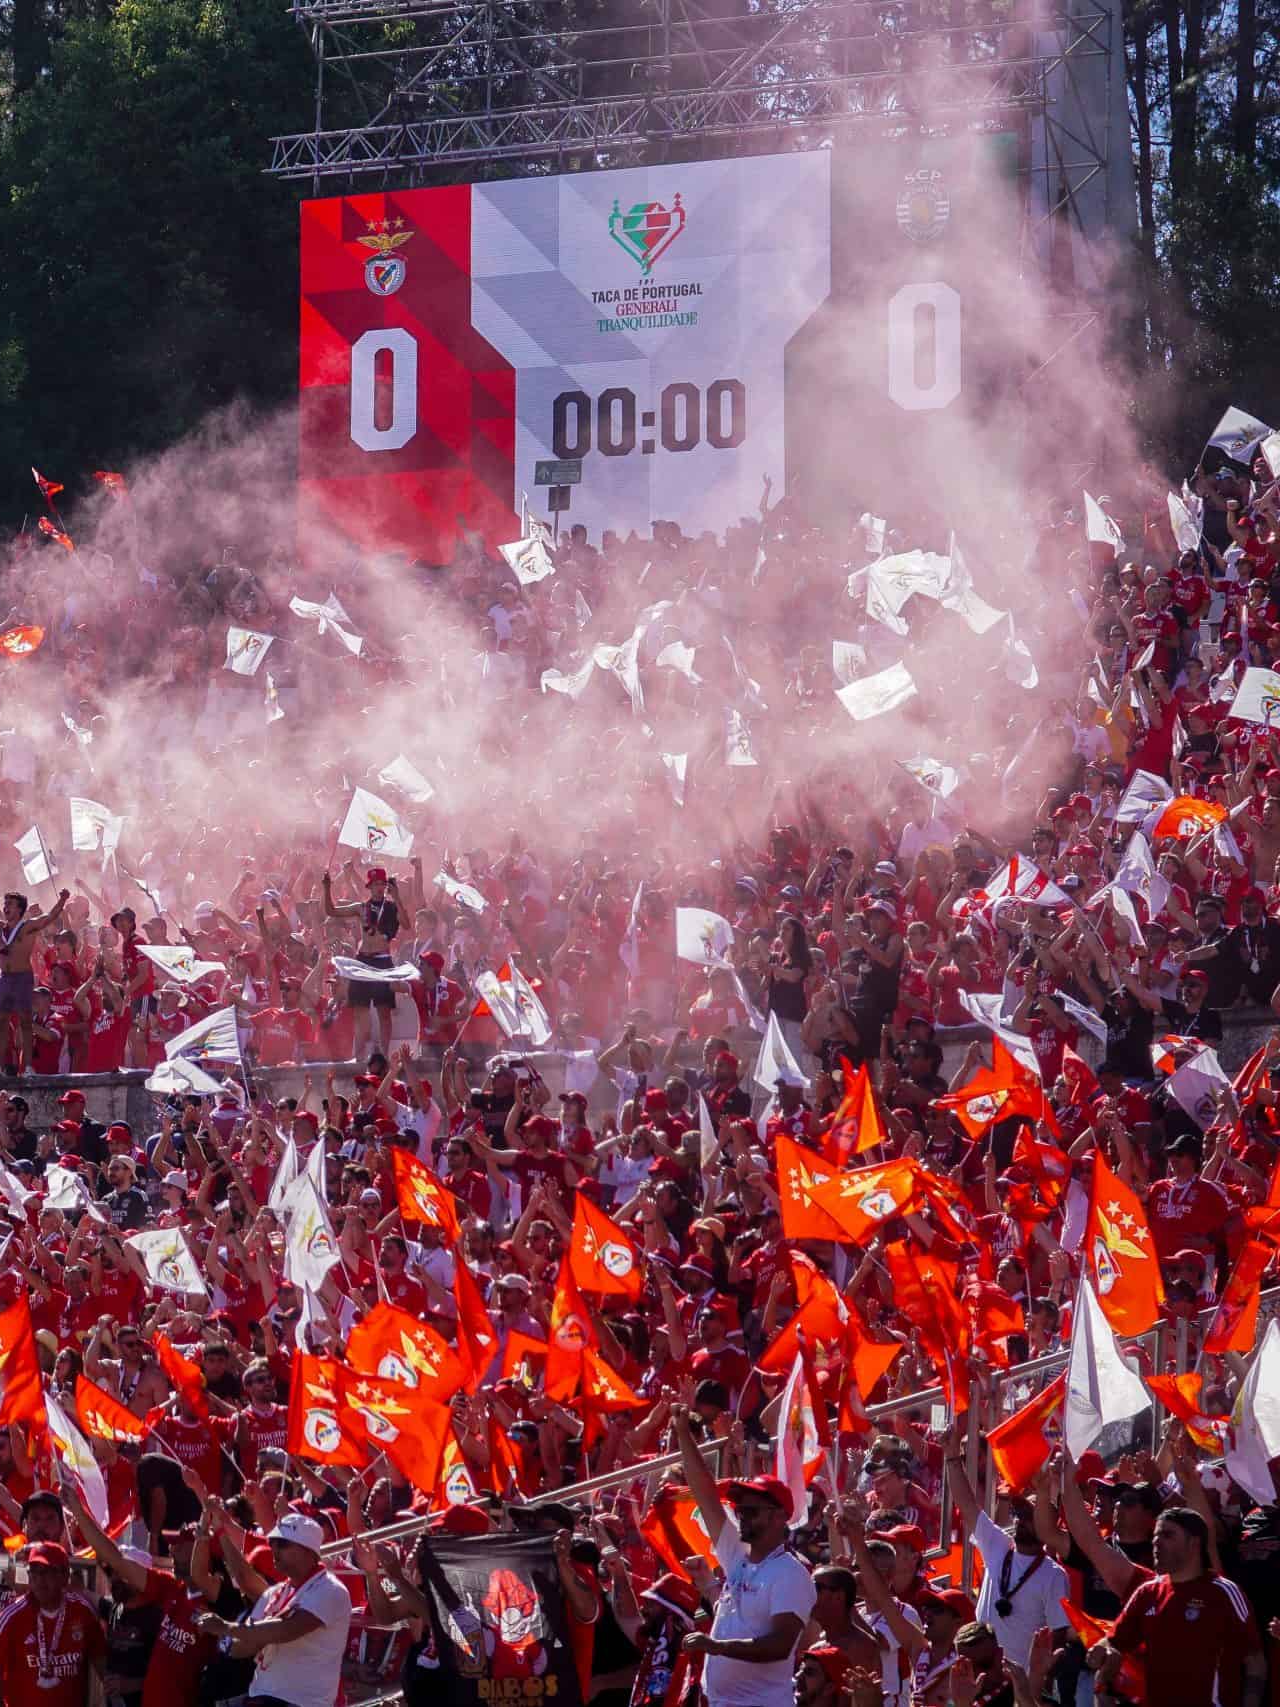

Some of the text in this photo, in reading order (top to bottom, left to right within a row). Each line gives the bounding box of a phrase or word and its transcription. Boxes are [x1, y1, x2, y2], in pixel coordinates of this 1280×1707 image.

[616, 300, 677, 317] GENERALI
[624, 288, 639, 301] DE
[642, 283, 703, 299] PORTUGAL
[597, 312, 698, 332] TRANQUILIDADE
[888, 282, 961, 411] 0
[351, 328, 418, 451] 0
[552, 378, 746, 459] 00:00
